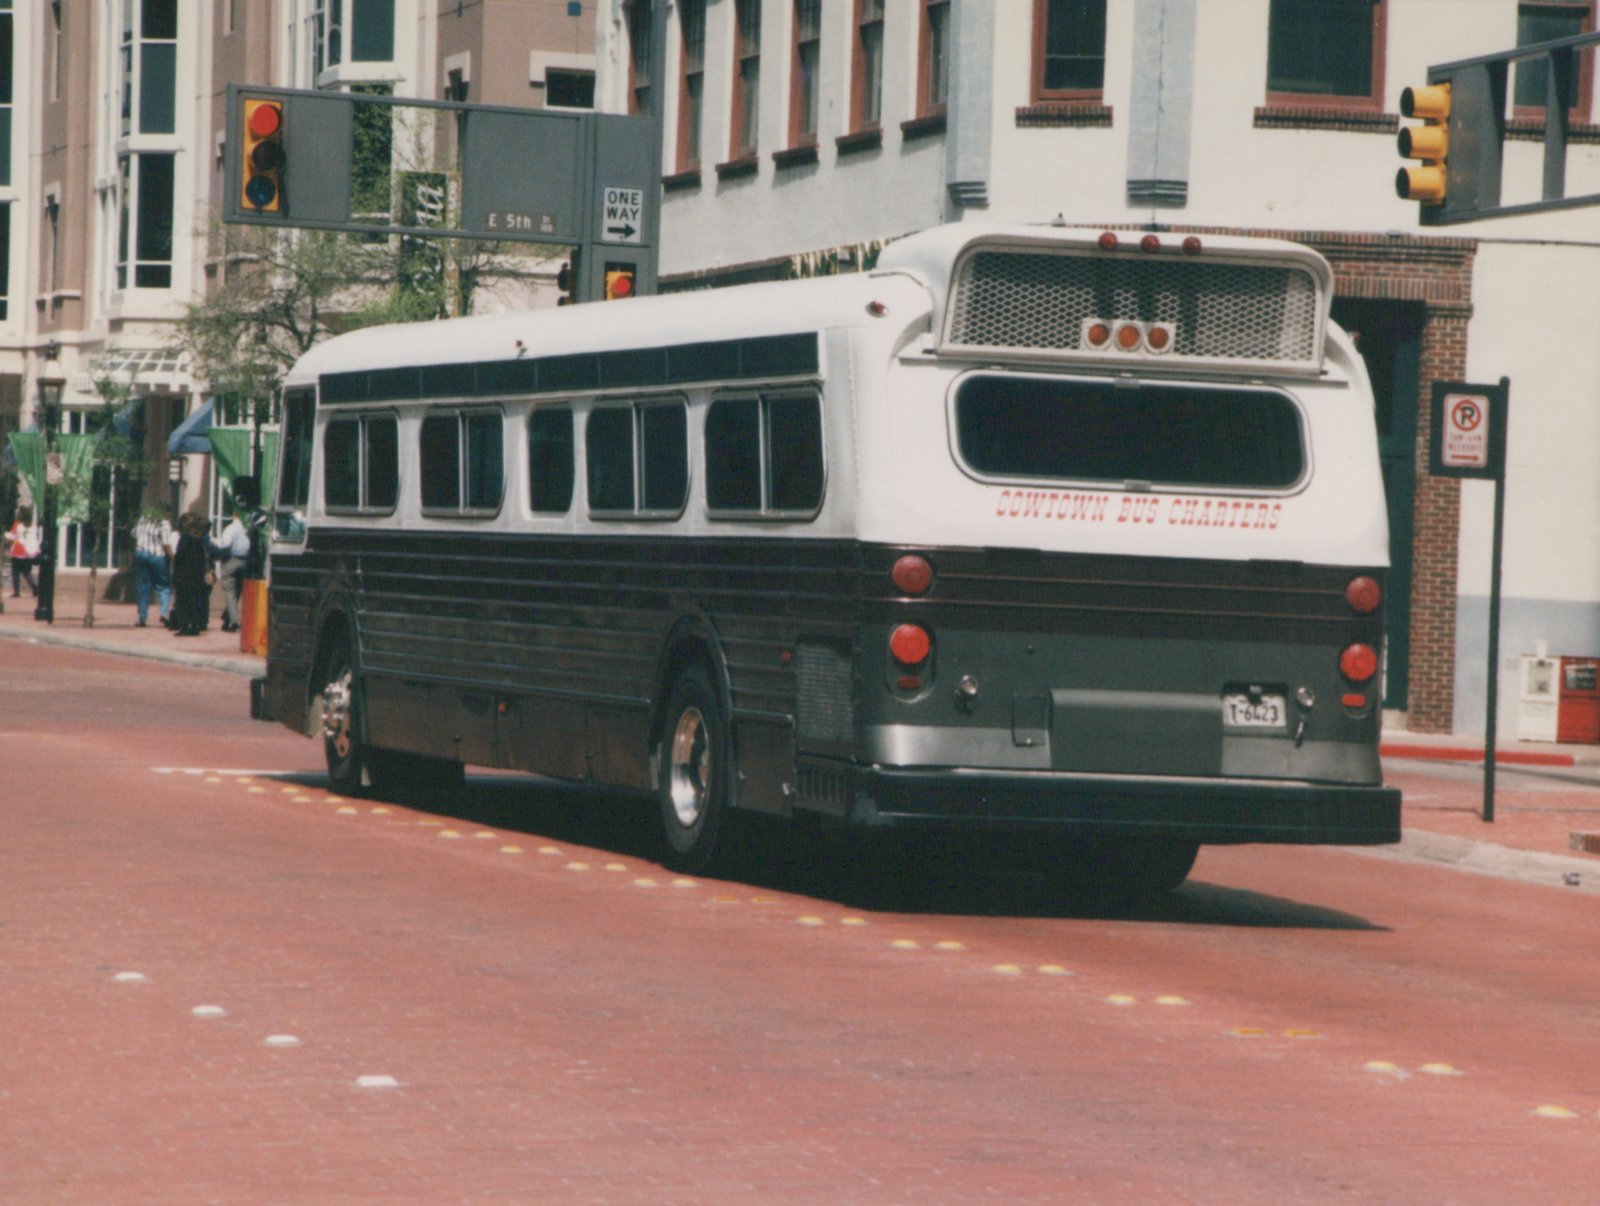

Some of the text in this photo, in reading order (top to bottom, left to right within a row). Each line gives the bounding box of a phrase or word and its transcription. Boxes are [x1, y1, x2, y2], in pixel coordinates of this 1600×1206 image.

[608, 190, 639, 206] ONE
[488, 213, 498, 228] E
[506, 213, 532, 230] 5th
[607, 207, 639, 221] WAY
[997, 490, 1281, 529] COWTOWN BUS CHARTERS
